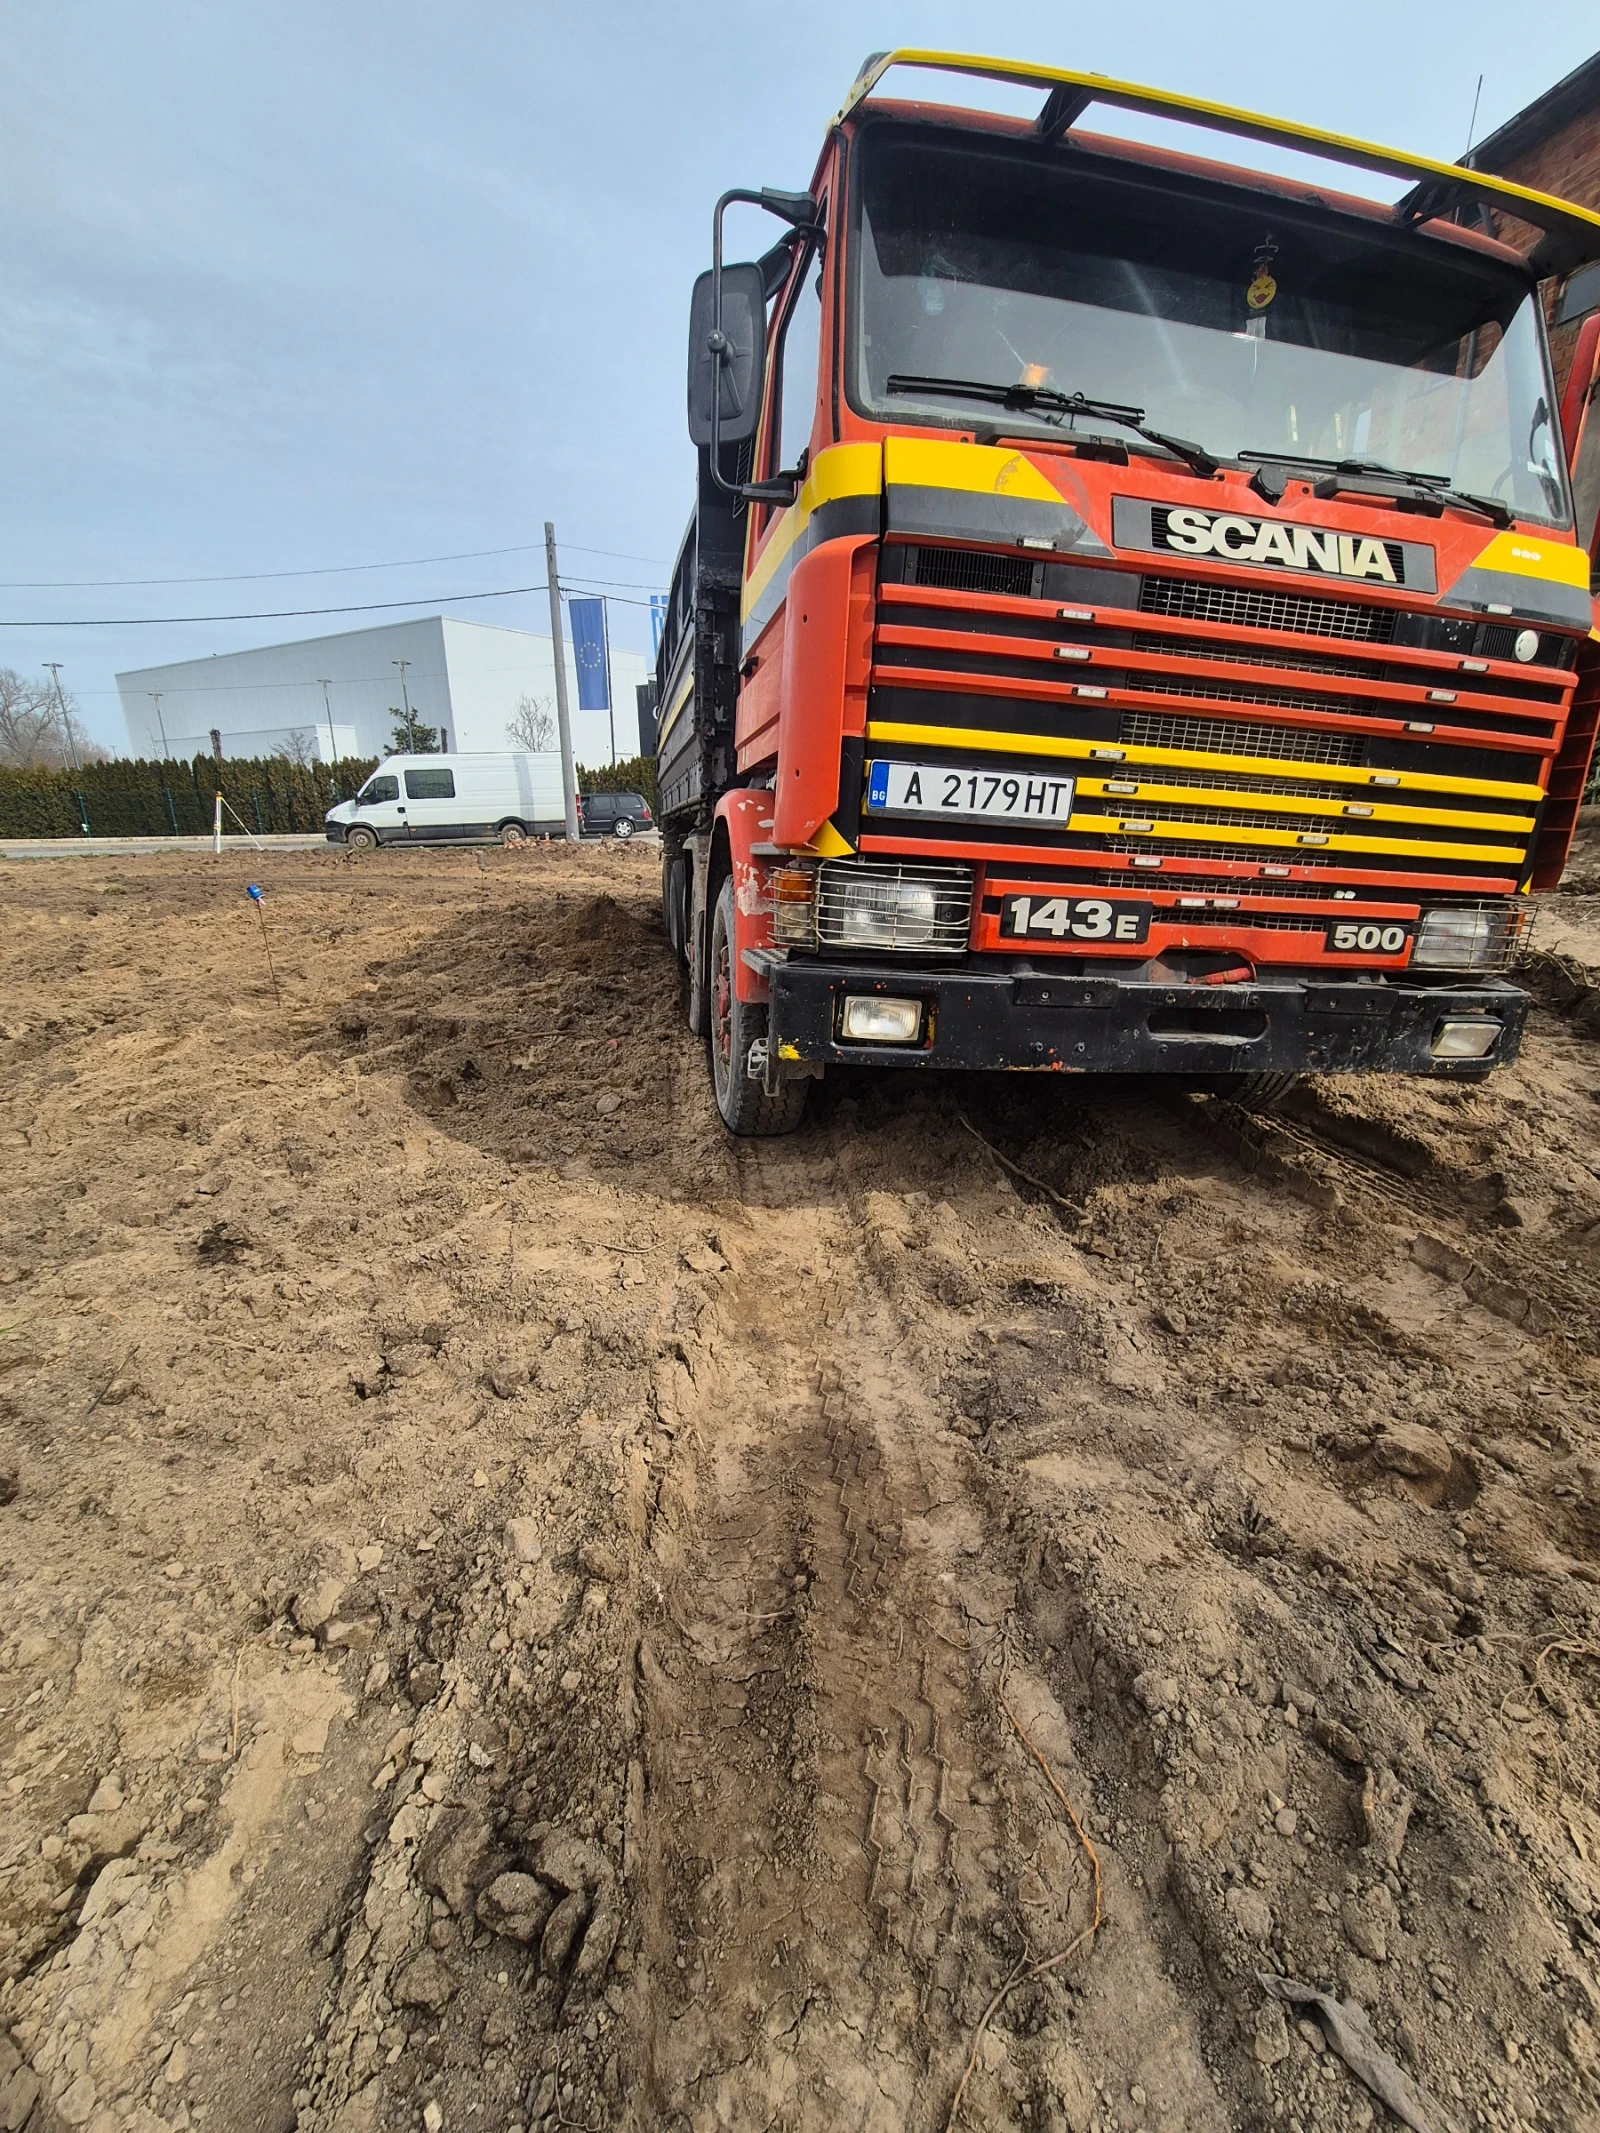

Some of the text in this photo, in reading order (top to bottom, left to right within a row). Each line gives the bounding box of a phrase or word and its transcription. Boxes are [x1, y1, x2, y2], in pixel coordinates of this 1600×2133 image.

[1166, 509, 1398, 582] SCANIA
[871, 789, 886, 801] BG
[903, 771, 923, 805] A
[1333, 925, 1405, 951] 500
